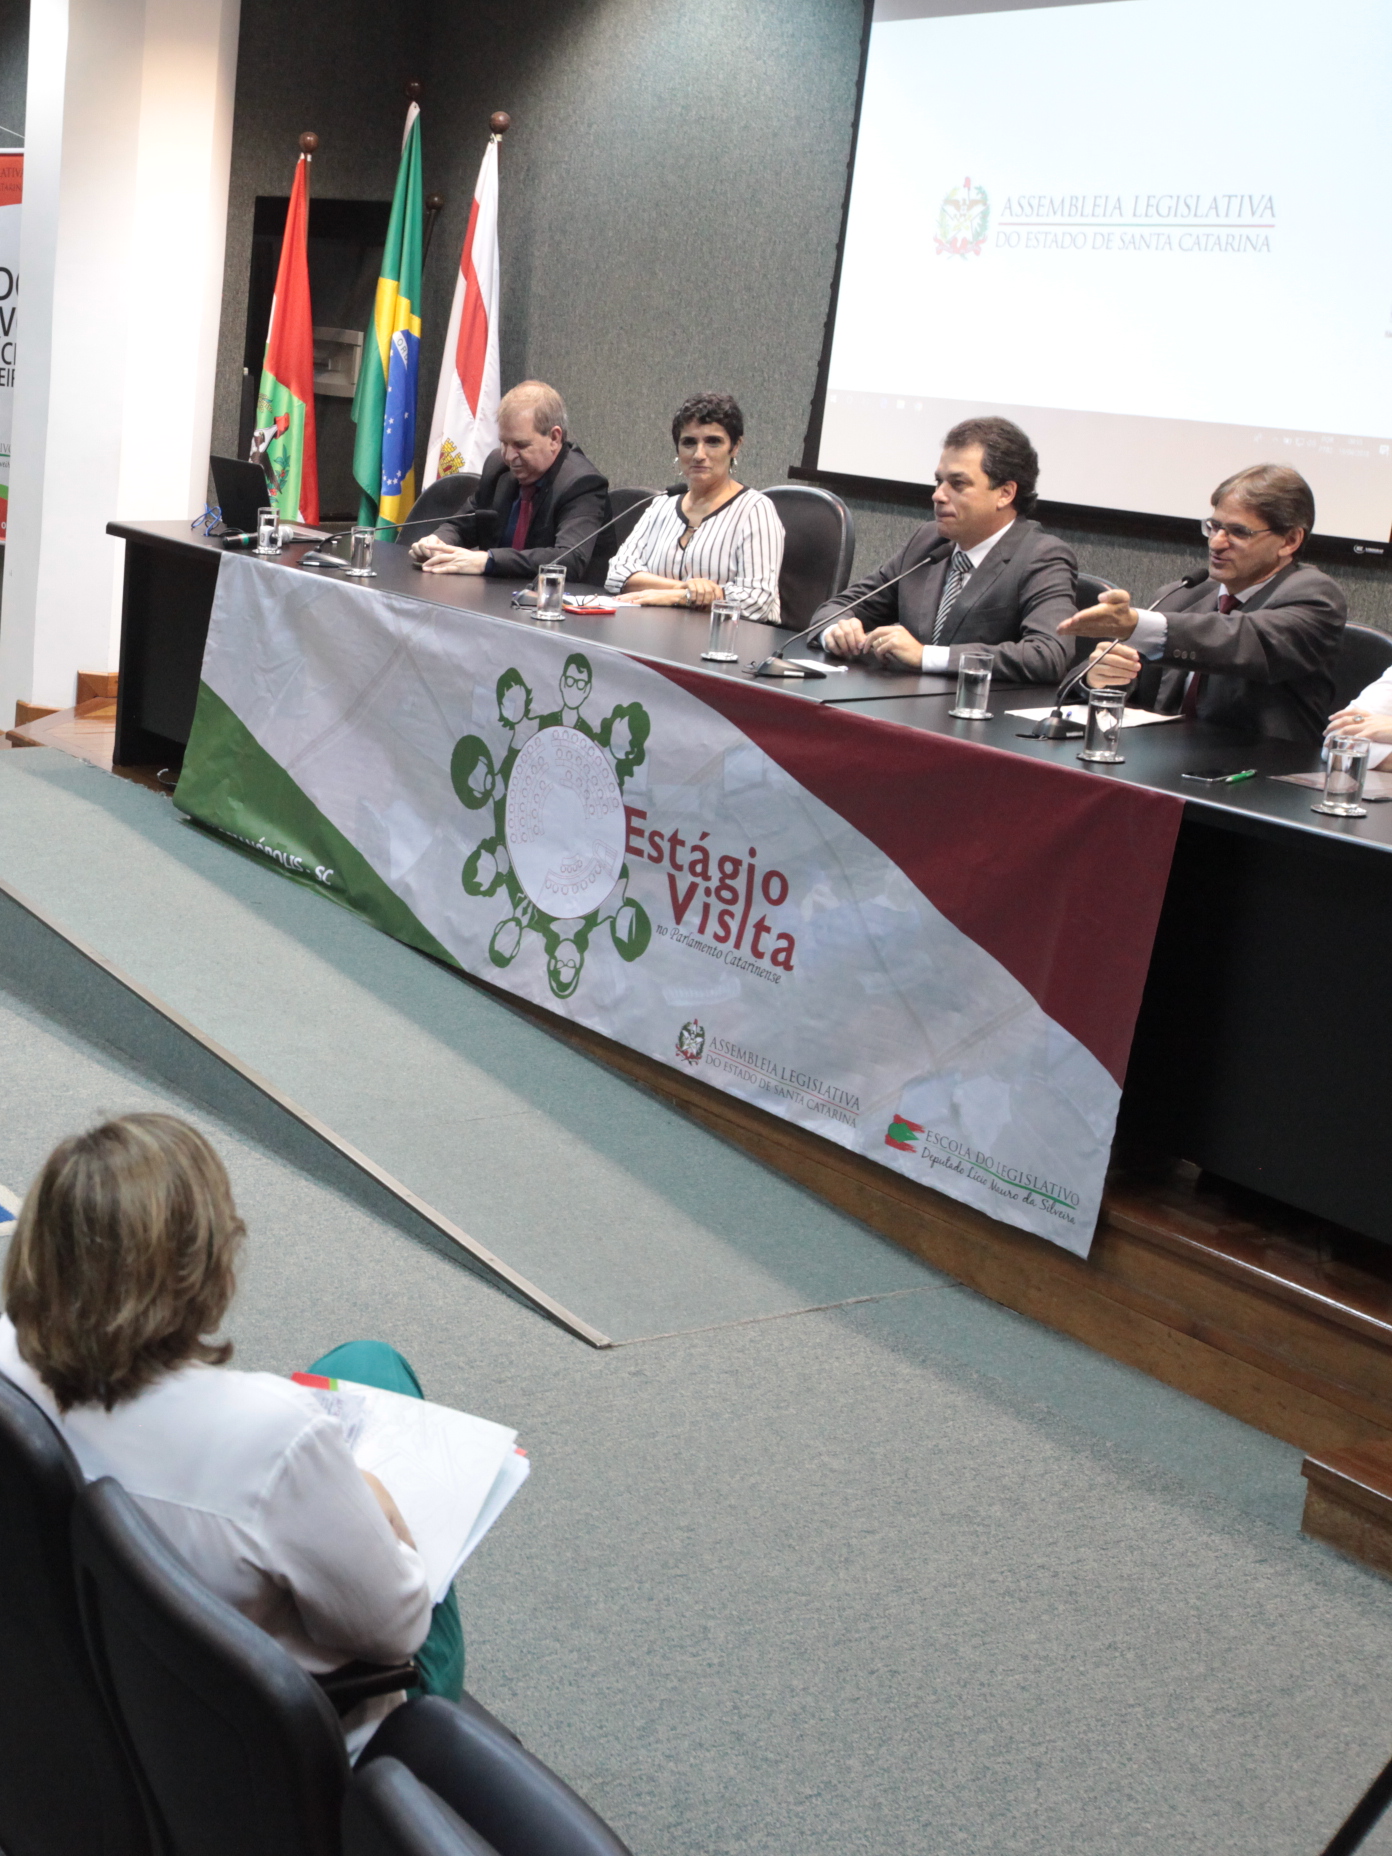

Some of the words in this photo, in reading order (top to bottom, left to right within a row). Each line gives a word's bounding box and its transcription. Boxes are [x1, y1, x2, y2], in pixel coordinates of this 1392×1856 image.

[995, 231, 1021, 249] DO
[1025, 231, 1087, 250] ESTADO
[1091, 232, 1115, 250] DE
[1118, 232, 1175, 251] SANTA
[1178, 233, 1272, 253] CATARINA
[1000, 195, 1124, 218] ASSEMBLEIA
[1132, 195, 1277, 219] LEGISLATIVA
[315, 865, 334, 885] SC
[623, 804, 789, 906] Estágio
[656, 923, 669, 937] no
[670, 927, 723, 960] Parlamento
[724, 950, 782, 985] Catarinense
[667, 871, 796, 972] Visita
[705, 1053, 722, 1068] DO
[723, 1061, 757, 1085] ESTADO
[758, 1077, 771, 1092] DE
[774, 1084, 805, 1106] SANTA
[806, 1099, 857, 1129] CATARINA
[709, 1036, 778, 1077] ASSEMBLEIA
[781, 1066, 860, 1111] LEGISLATIVA
[921, 1146, 964, 1175] Deputado
[1022, 1191, 1037, 1207] da
[1039, 1198, 1076, 1225] Silveira
[925, 1130, 971, 1160] ESCOLA
[975, 1151, 994, 1169] DO
[996, 1161, 1080, 1207] LEGISLATIVO
